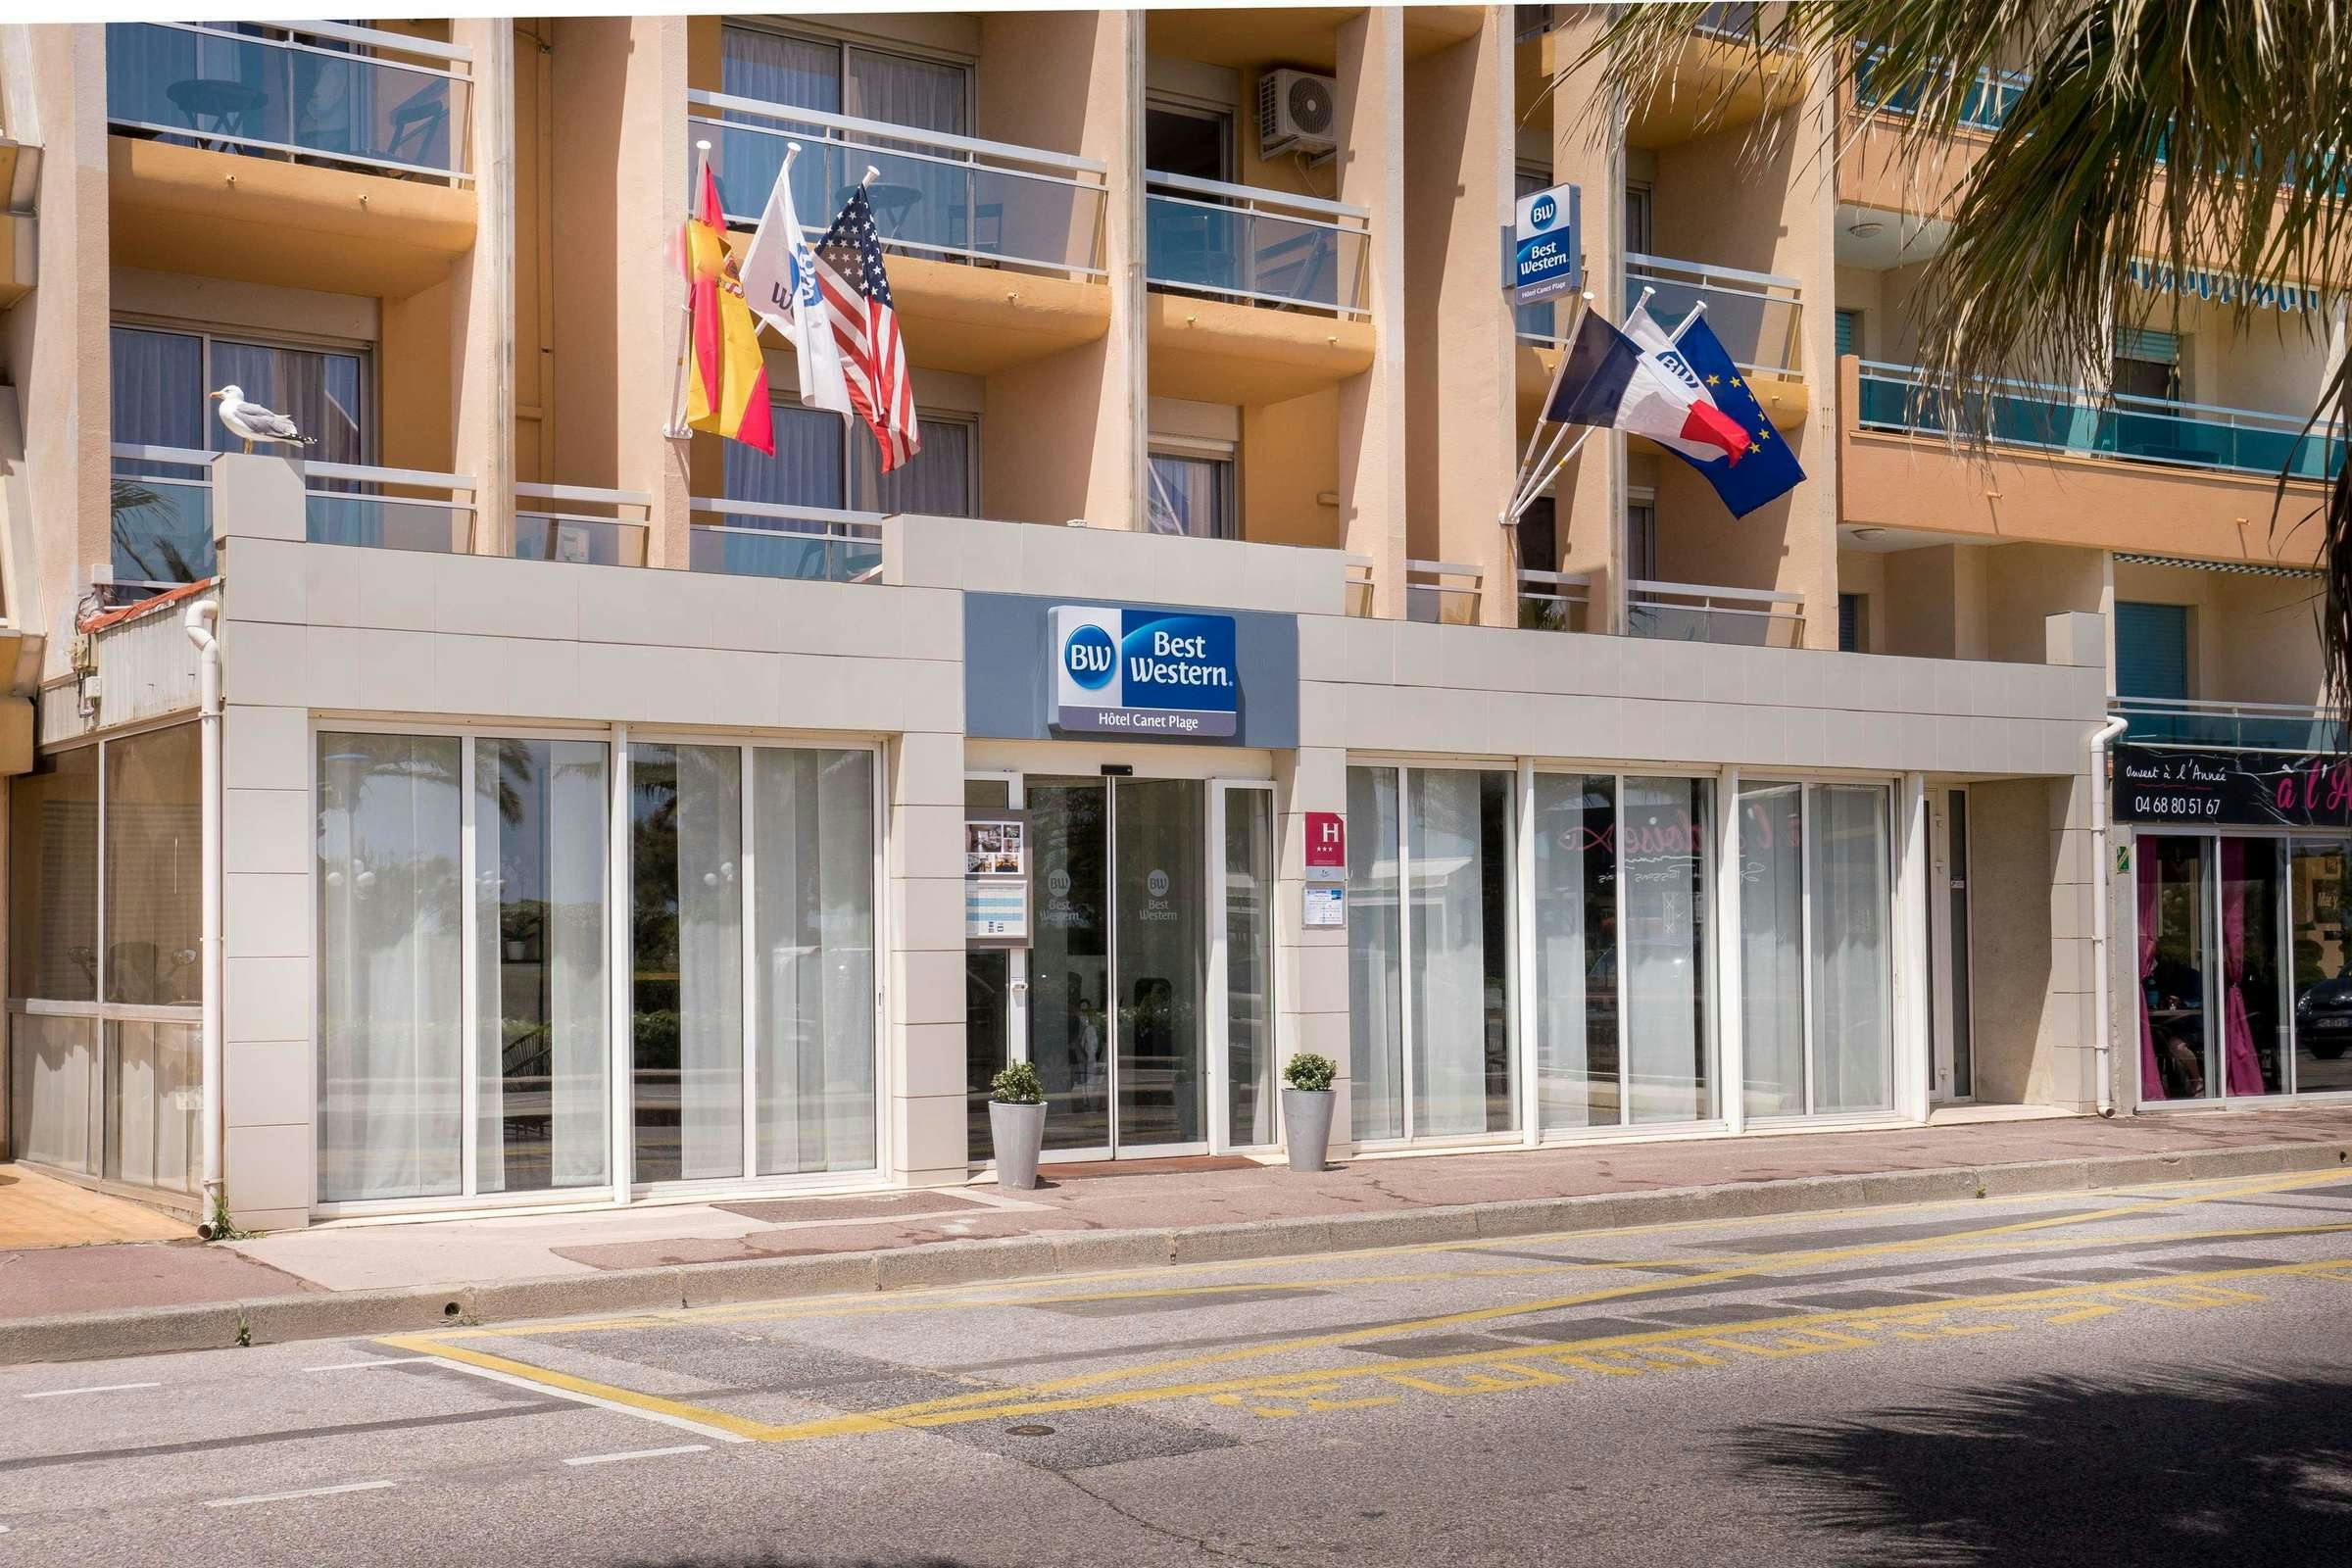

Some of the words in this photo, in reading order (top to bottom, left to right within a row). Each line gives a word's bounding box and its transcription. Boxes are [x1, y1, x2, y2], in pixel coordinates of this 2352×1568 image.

[1533, 203, 1554, 222] BW
[1531, 241, 1557, 260] Best
[1520, 253, 1567, 275] Western
[1153, 630, 1206, 660] Best
[1070, 644, 1111, 672] BW
[1099, 711, 1130, 726] Hôtel
[1133, 713, 1166, 727] Canet
[1168, 714, 1199, 731] Plage
[2126, 764, 2160, 778] Ouvert
[2163, 763, 2172, 779] à
[2135, 796, 2150, 812] 04
[2153, 797, 2168, 813] 68
[2171, 798, 2186, 814] 80
[2188, 798, 2202, 814] 51
[2206, 799, 2221, 815] 67
[1322, 822, 1340, 843] H
[1051, 877, 1068, 890] BW
[1150, 877, 1166, 890] BW
[1049, 900, 1071, 910] Best
[1149, 900, 1169, 909] Best
[1139, 909, 1177, 920] Western
